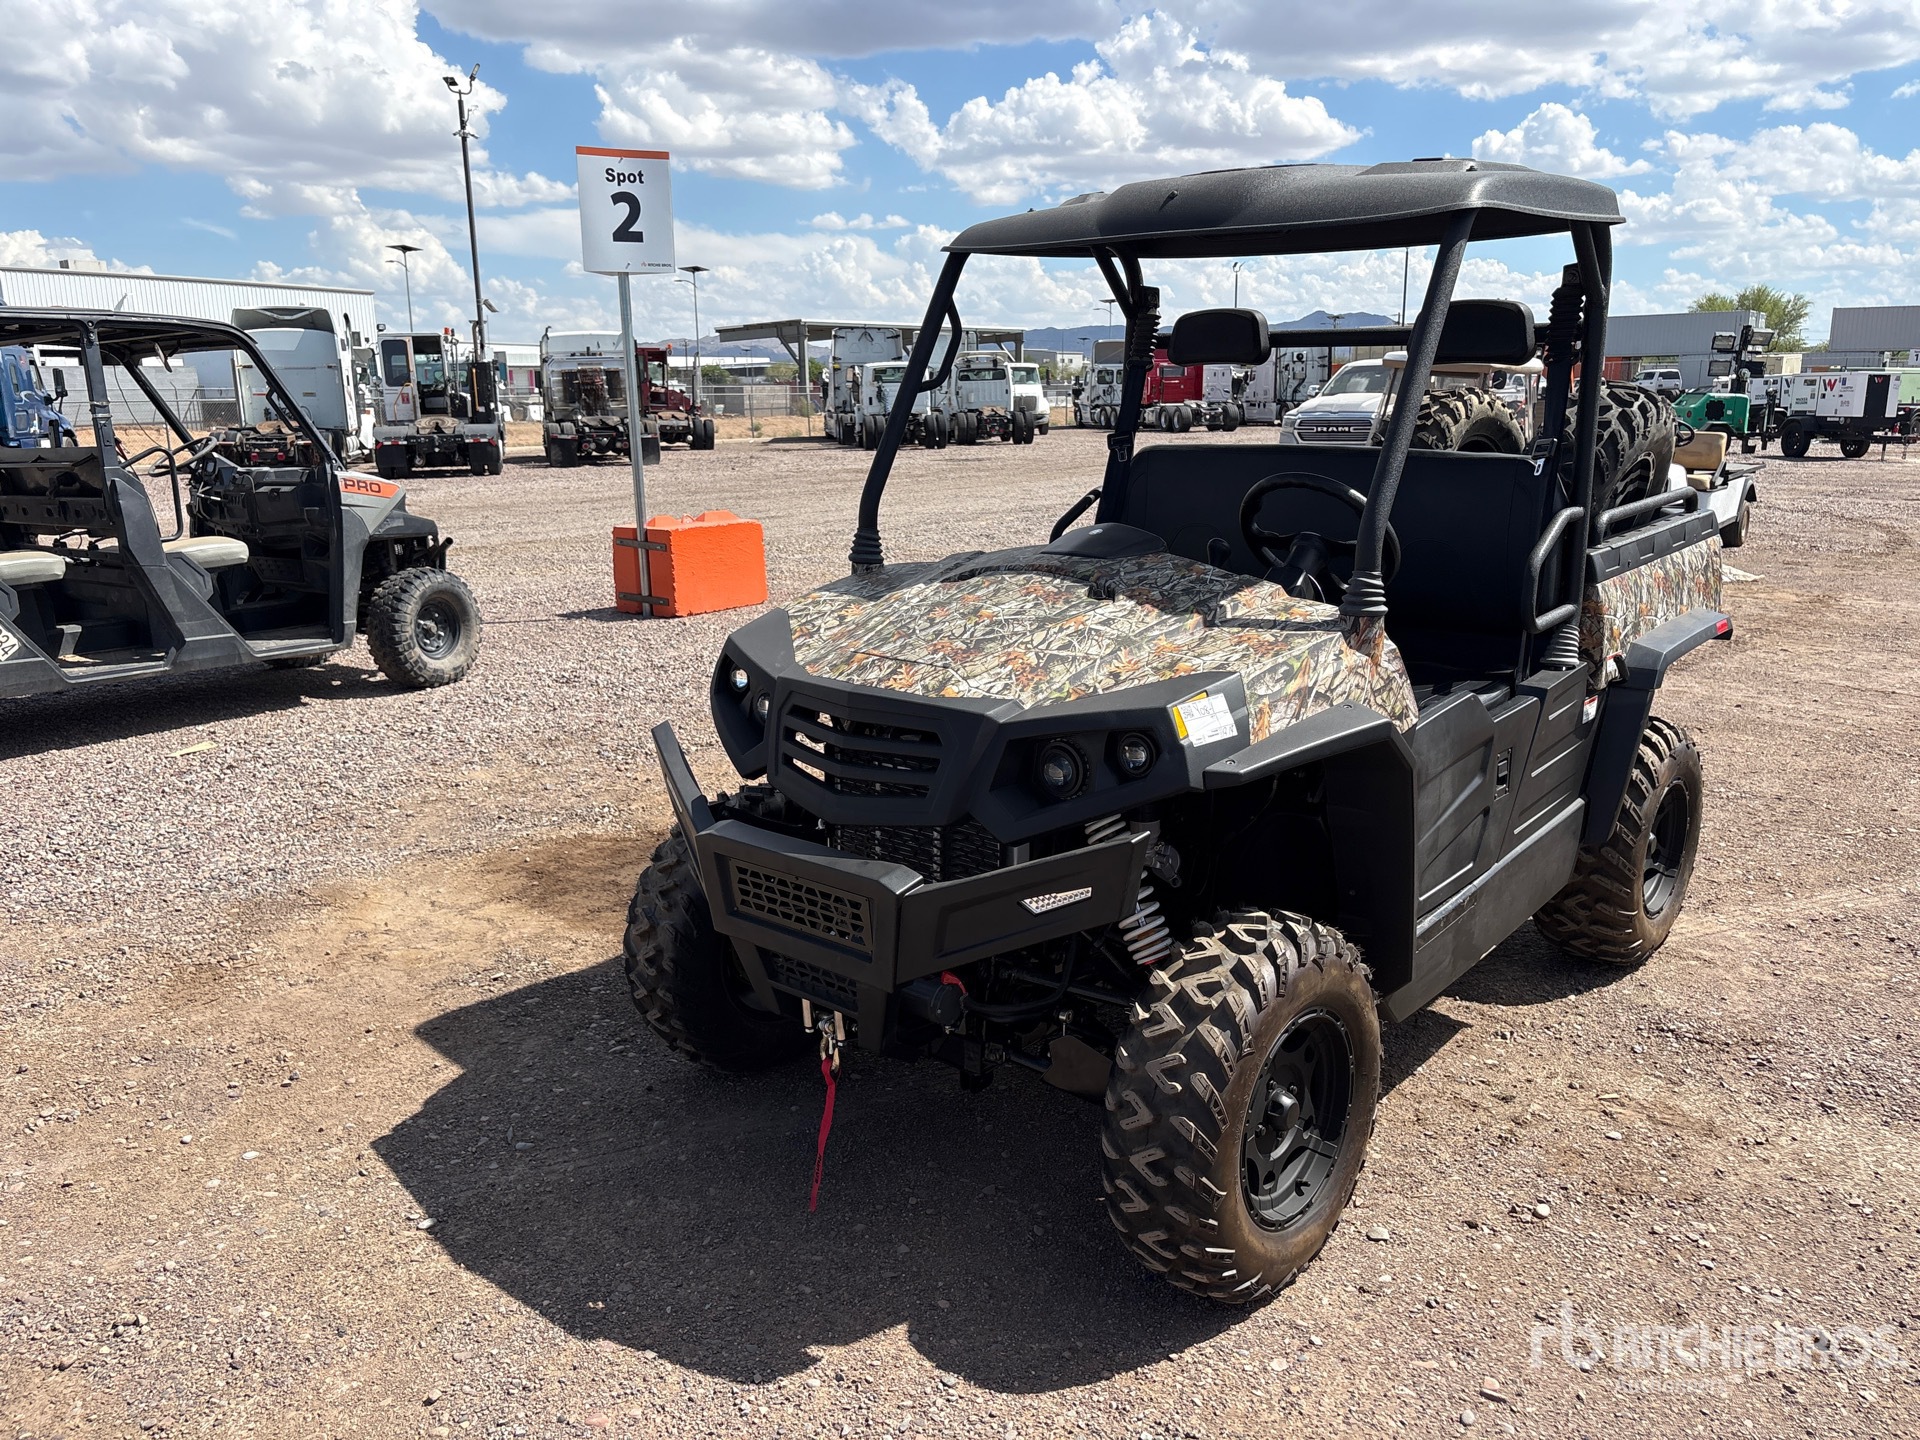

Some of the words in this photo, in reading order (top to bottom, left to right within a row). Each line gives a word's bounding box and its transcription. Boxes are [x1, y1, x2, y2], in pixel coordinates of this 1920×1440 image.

[605, 167, 645, 187] Spot
[610, 191, 644, 243] 2
[343, 478, 382, 494] PRO
